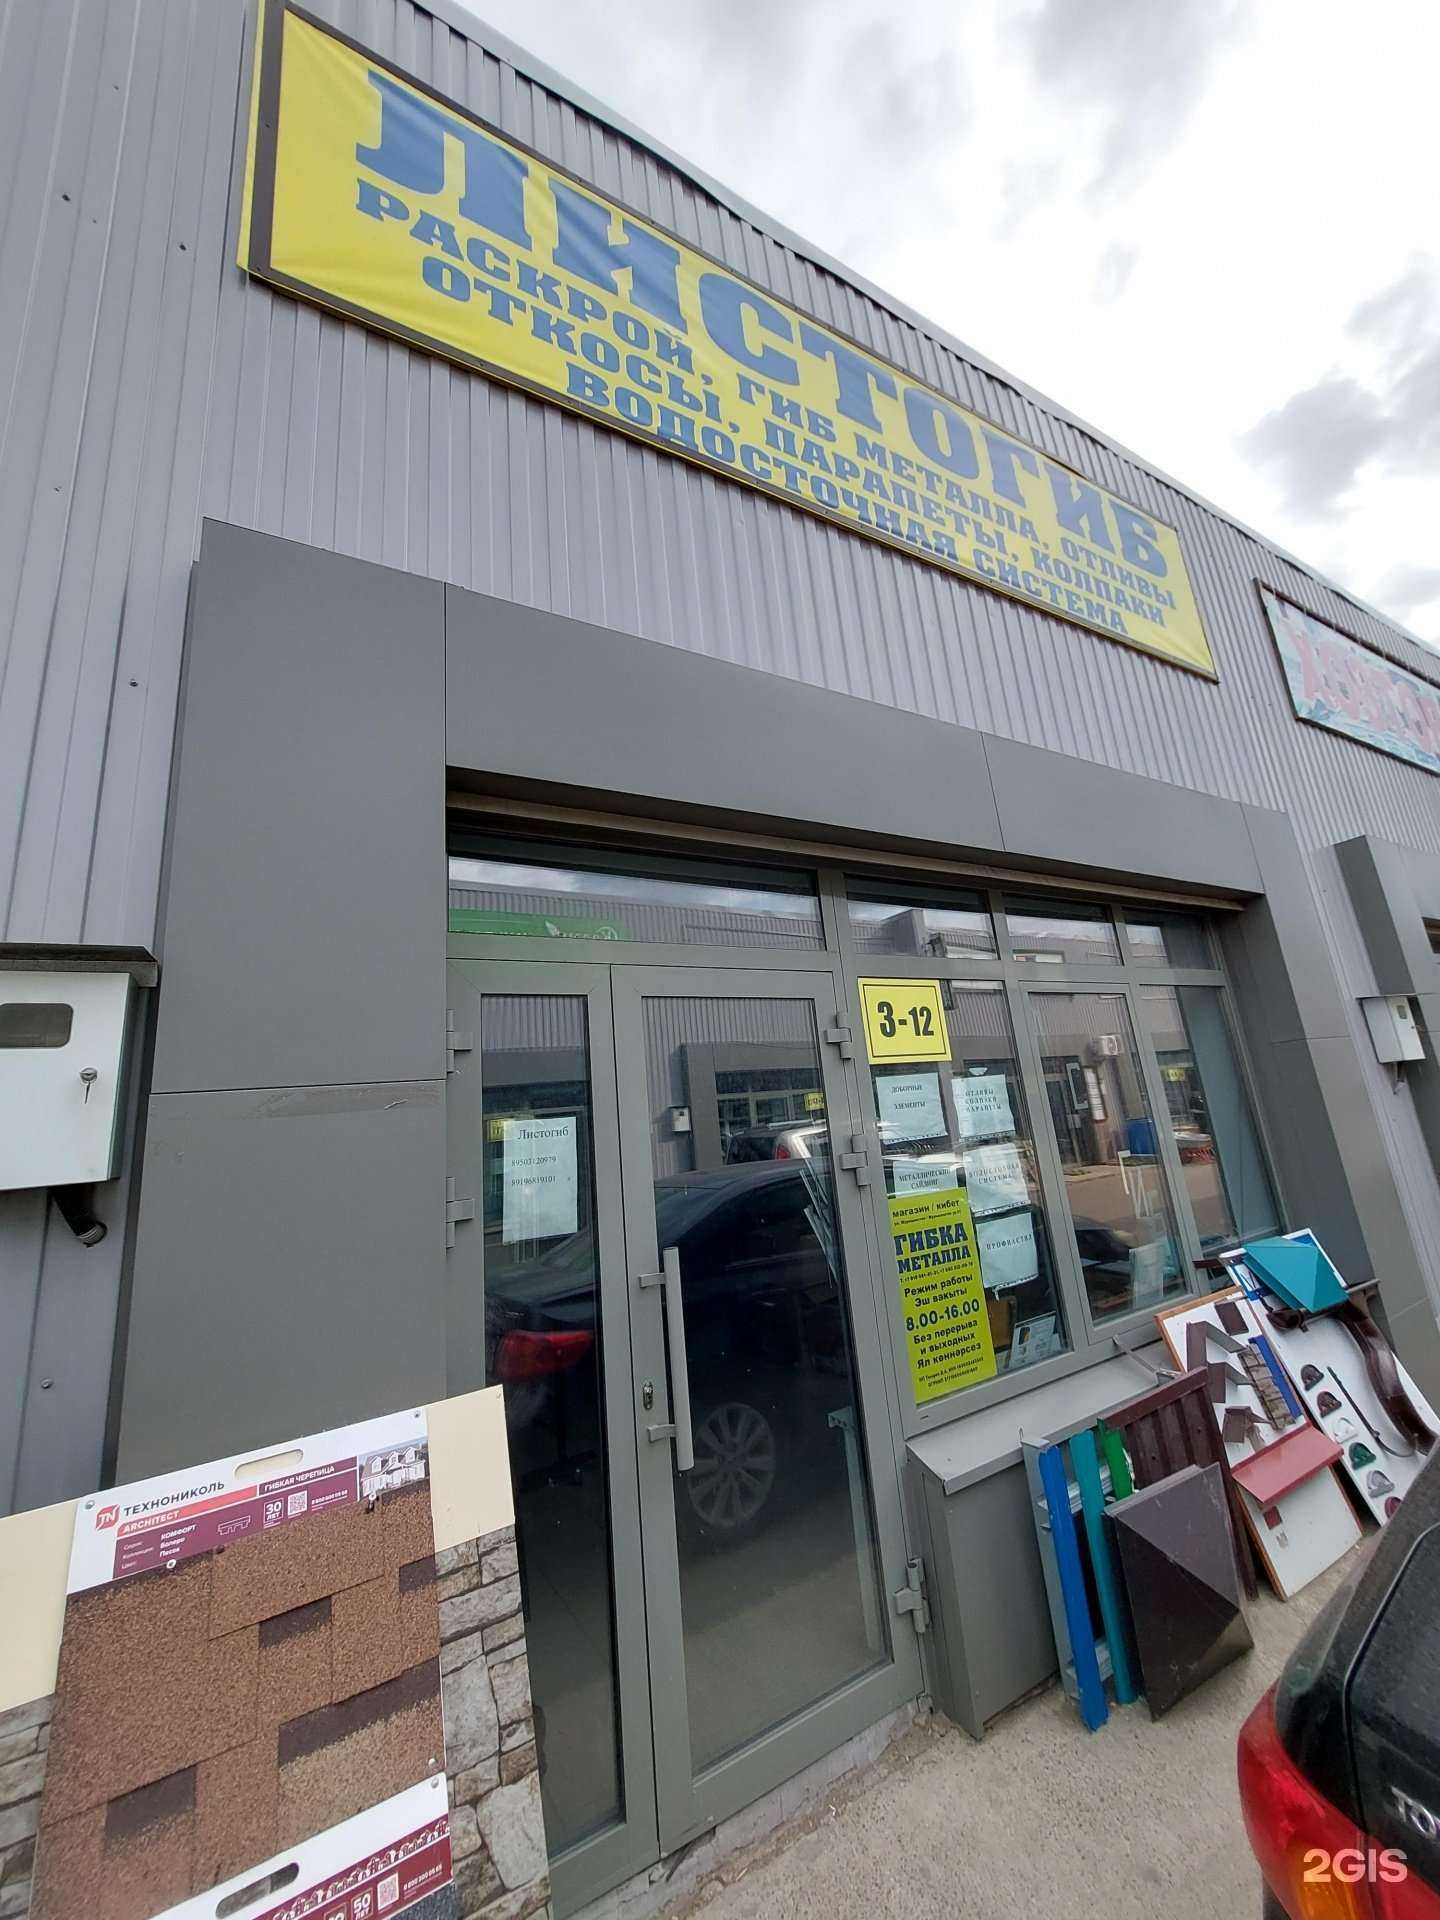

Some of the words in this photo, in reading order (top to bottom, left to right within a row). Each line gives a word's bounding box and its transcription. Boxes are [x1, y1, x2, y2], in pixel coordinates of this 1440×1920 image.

[355, 68, 1168, 578] ЛИСТОГИБ
[356, 178, 712, 386] РАСКРОЙ,
[737, 373, 837, 443] ГИБ
[855, 432, 1049, 550] МЕТАЛЛА,
[1061, 538, 1177, 609] ОТЛИВЫ
[422, 256, 740, 434] ОТКОСЫ,
[764, 418, 1020, 567] ПАРАПЕТЫ,
[1033, 548, 1167, 627] КОЛПАКИ
[567, 361, 959, 562] ВОДОСТОЧНАЯ
[974, 550, 1128, 634] СИСТЕМА
[877, 1001, 934, 1037] 3-12
[517, 1125, 569, 1140] Листогиб
[892, 1205, 930, 1218] магазин
[936, 1199, 960, 1210] кибет
[893, 1222, 969, 1256] ГИБКА
[896, 1245, 972, 1274] МЕТАЛЛА
[904, 1283, 938, 1298] Режим
[940, 1274, 973, 1291] работы
[914, 1298, 930, 1307] Эш
[932, 1288, 968, 1303] вакыты
[905, 1298, 980, 1332] 8.00-16.00
[913, 1333, 932, 1345] Без
[934, 1319, 978, 1339] перерыва
[929, 1332, 976, 1353] выходных
[917, 1358, 931, 1369] Ял
[264, 1476, 294, 1492] ГИБКАЯ
[296, 1465, 335, 1483] ЧЕРЕПИЦА
[123, 1481, 225, 1516] ТЕХНОНИКОЛЬ
[265, 1501, 282, 1515] 30
[122, 1510, 181, 1534] ARCHITECT
[266, 1511, 280, 1520] ЛЕТ
[160, 1524, 198, 1541] КОМФОРТ
[353, 1893, 371, 1913] 50
